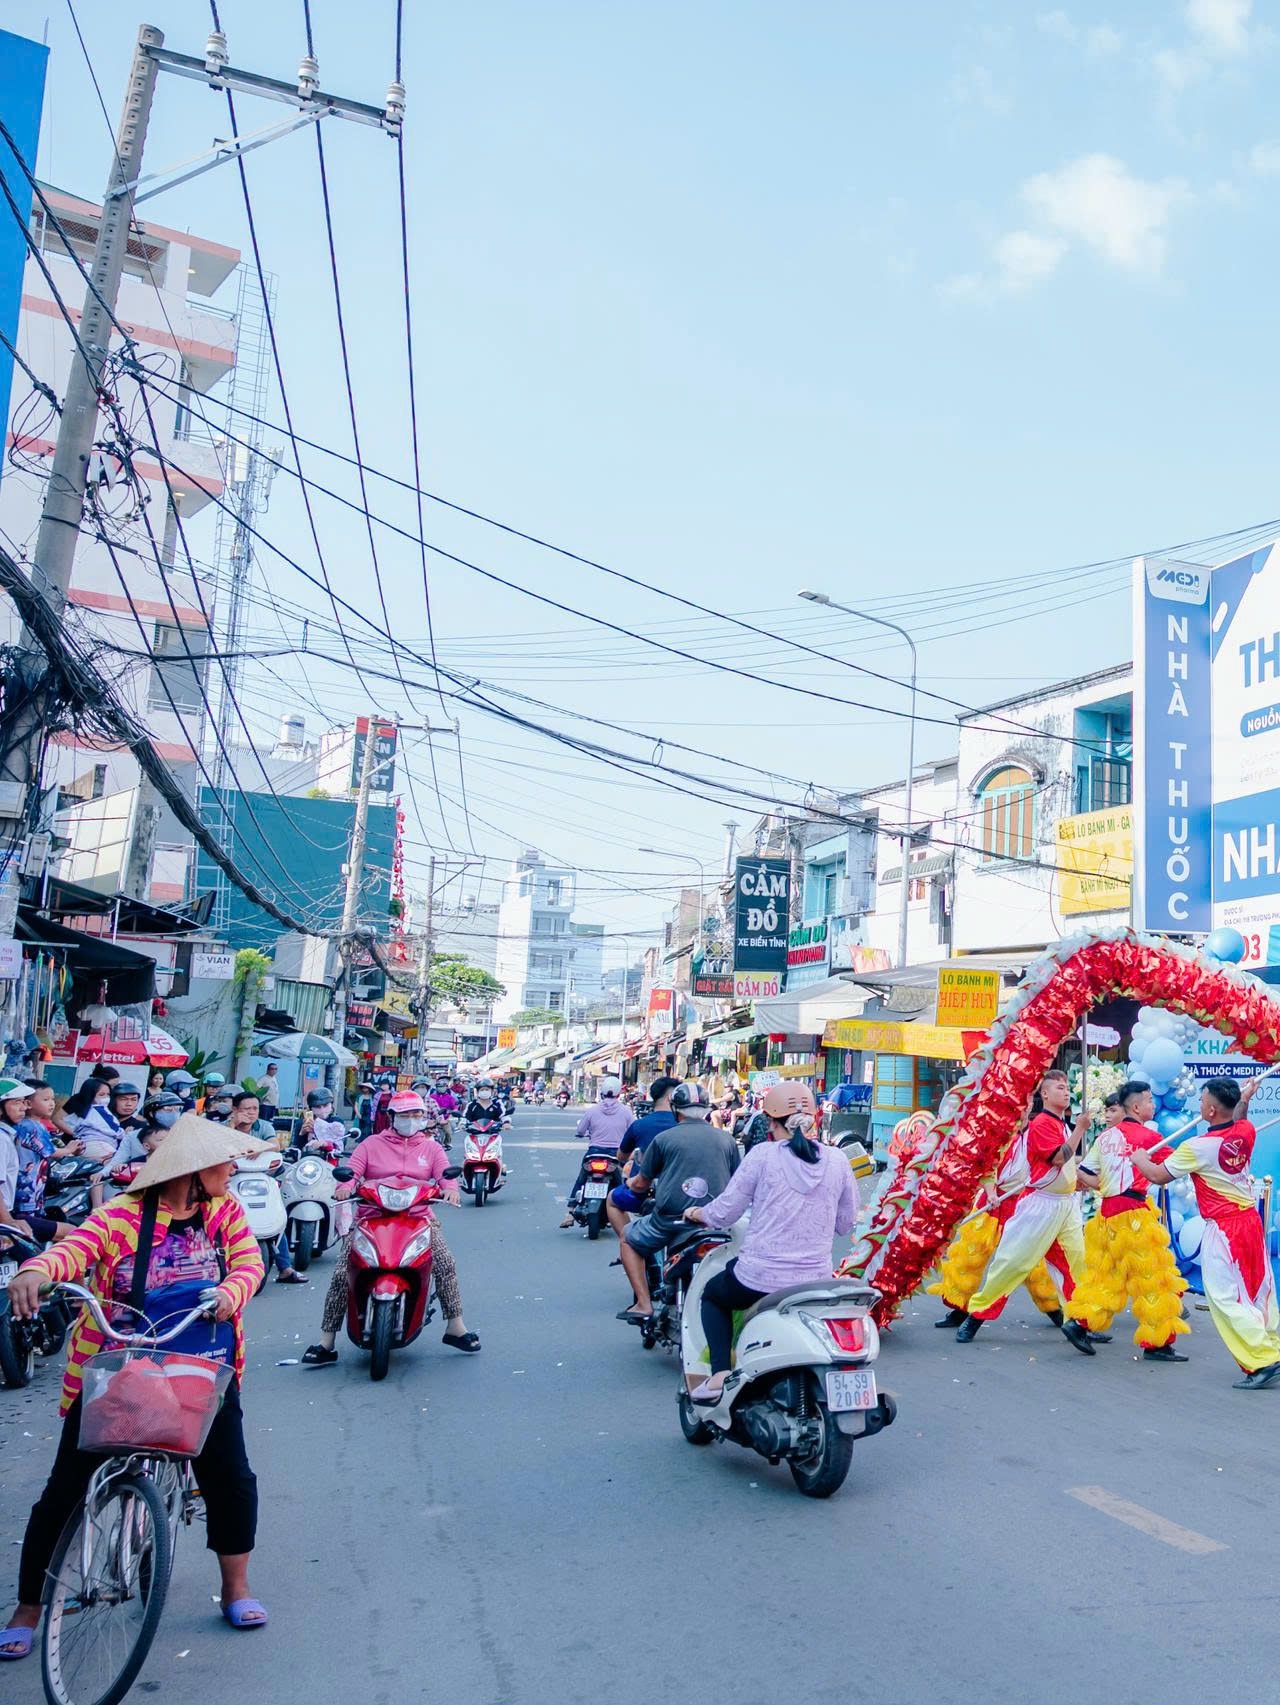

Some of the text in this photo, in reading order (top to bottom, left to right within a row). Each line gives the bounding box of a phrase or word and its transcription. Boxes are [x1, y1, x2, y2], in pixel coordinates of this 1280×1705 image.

[1167, 615, 1188, 717] NHÀ
[1166, 742, 1190, 921] THUỐC
[740, 863, 787, 898] CẦM
[747, 898, 778, 932] ĐỒ
[738, 938, 749, 947] XE
[207, 956, 230, 965] VIAN
[736, 975, 779, 997] CẦM ĐỒ
[150, 1037, 172, 1050] 5G
[92, 1051, 136, 1063] vettel
[1201, 1064, 1232, 1076] THUỐC
[1233, 1067, 1254, 1076] MEDI
[834, 1374, 868, 1390] 54-S9
[836, 1390, 870, 1408] 2008
